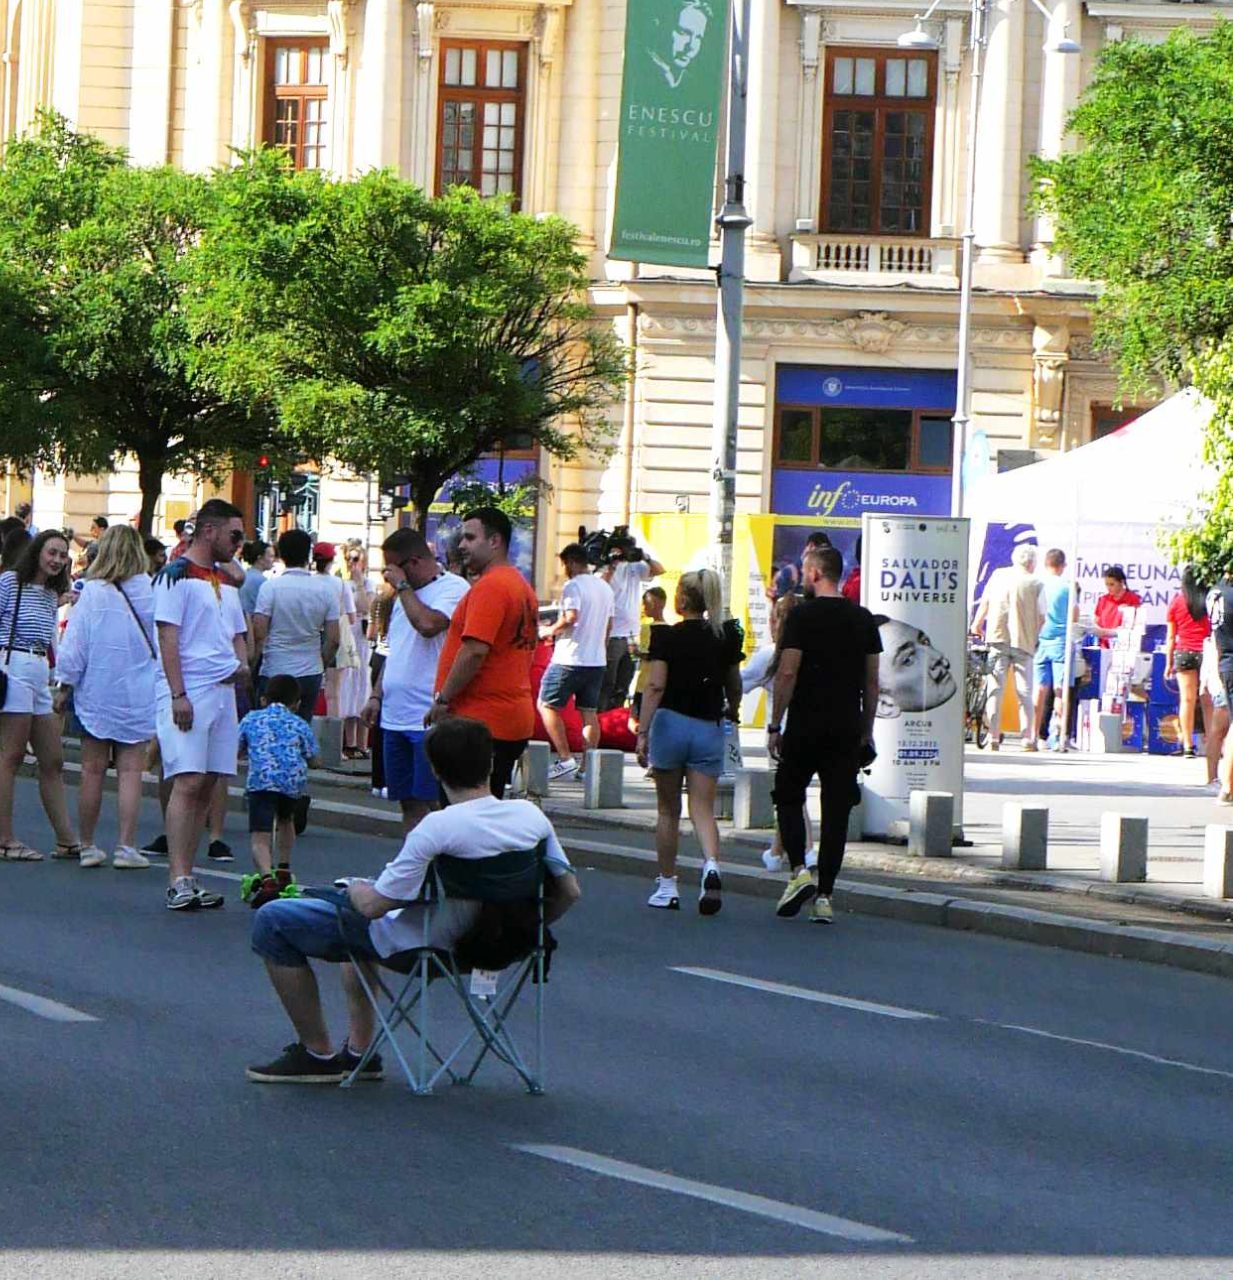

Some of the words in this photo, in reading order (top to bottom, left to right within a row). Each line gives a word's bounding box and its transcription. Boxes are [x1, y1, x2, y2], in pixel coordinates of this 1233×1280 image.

[629, 104, 713, 127] ENESCU
[628, 125, 711, 143] FESTIVAL
[882, 558, 958, 570] SALVADOR
[880, 571, 958, 590] DALI'S
[881, 591, 956, 603] UNIVERSE
